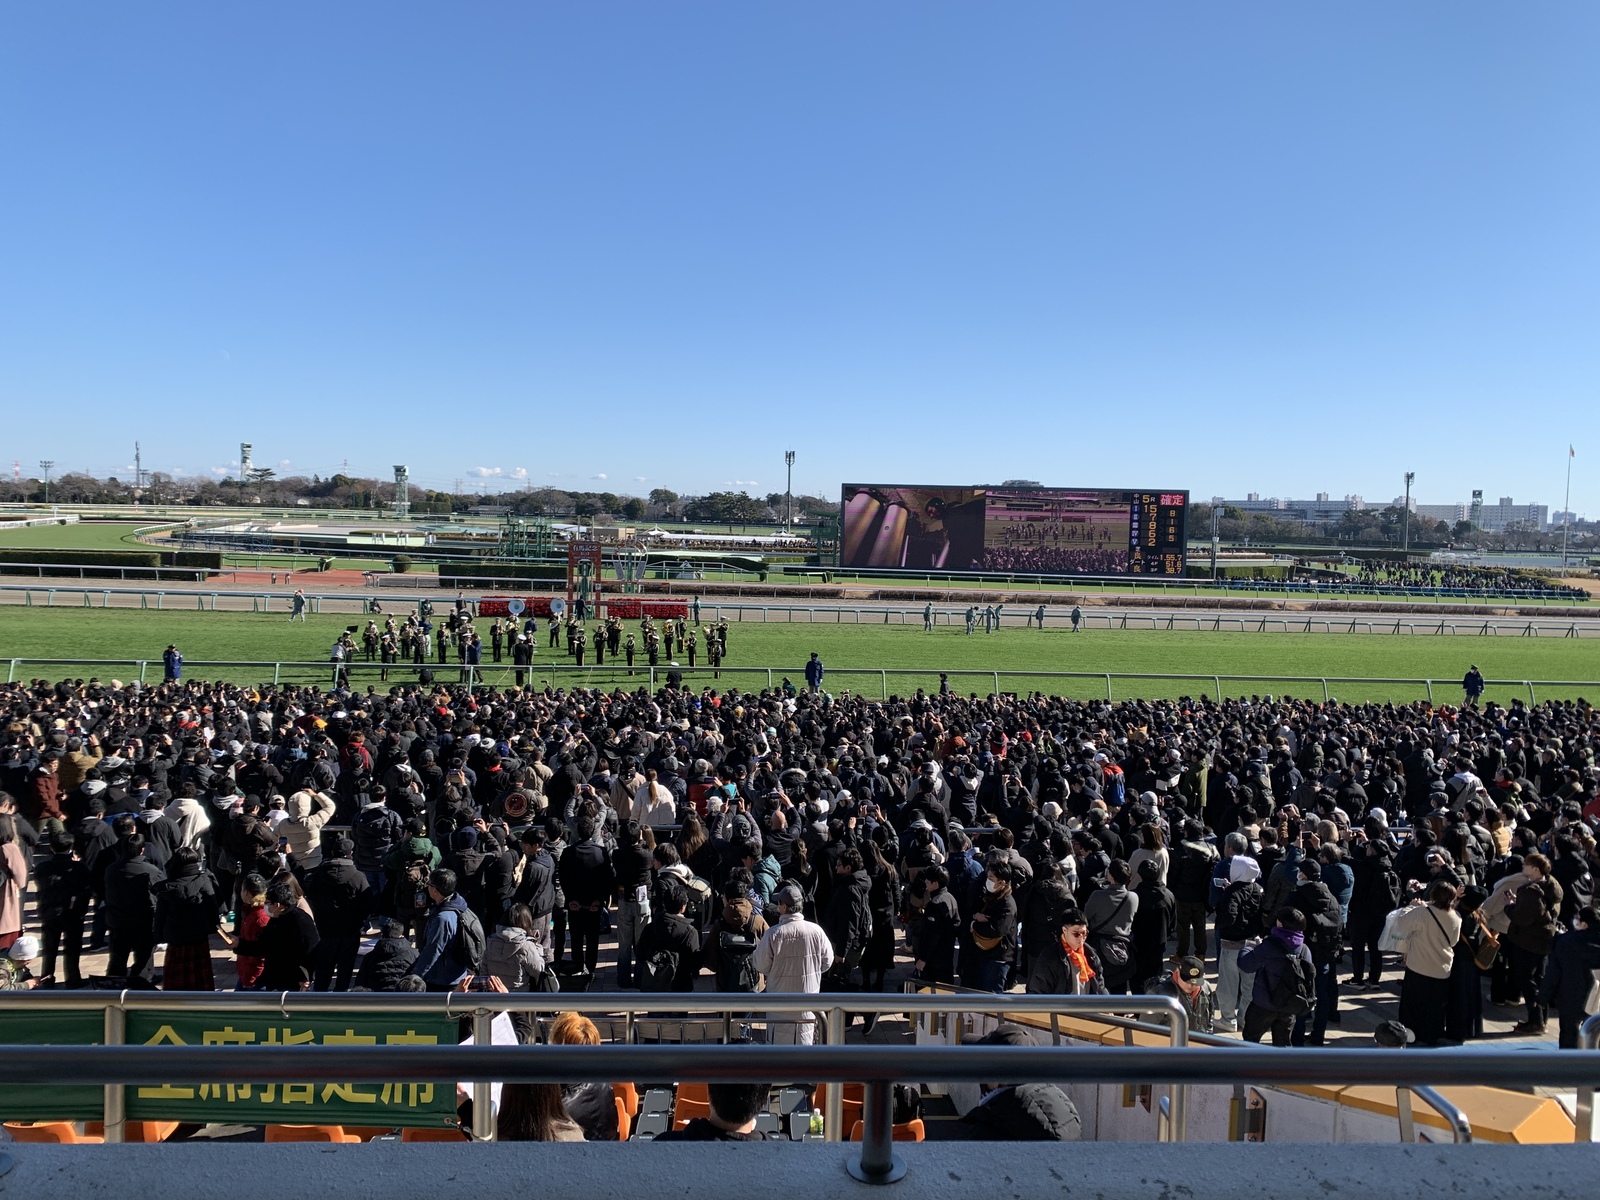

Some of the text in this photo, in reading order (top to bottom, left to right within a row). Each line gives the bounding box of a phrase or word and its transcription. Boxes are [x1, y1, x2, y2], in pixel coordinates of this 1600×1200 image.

[1160, 494, 1184, 506] 確定
[1144, 504, 1158, 513] 15
[1148, 521, 1157, 529] 8
[1148, 538, 1156, 547] 2
